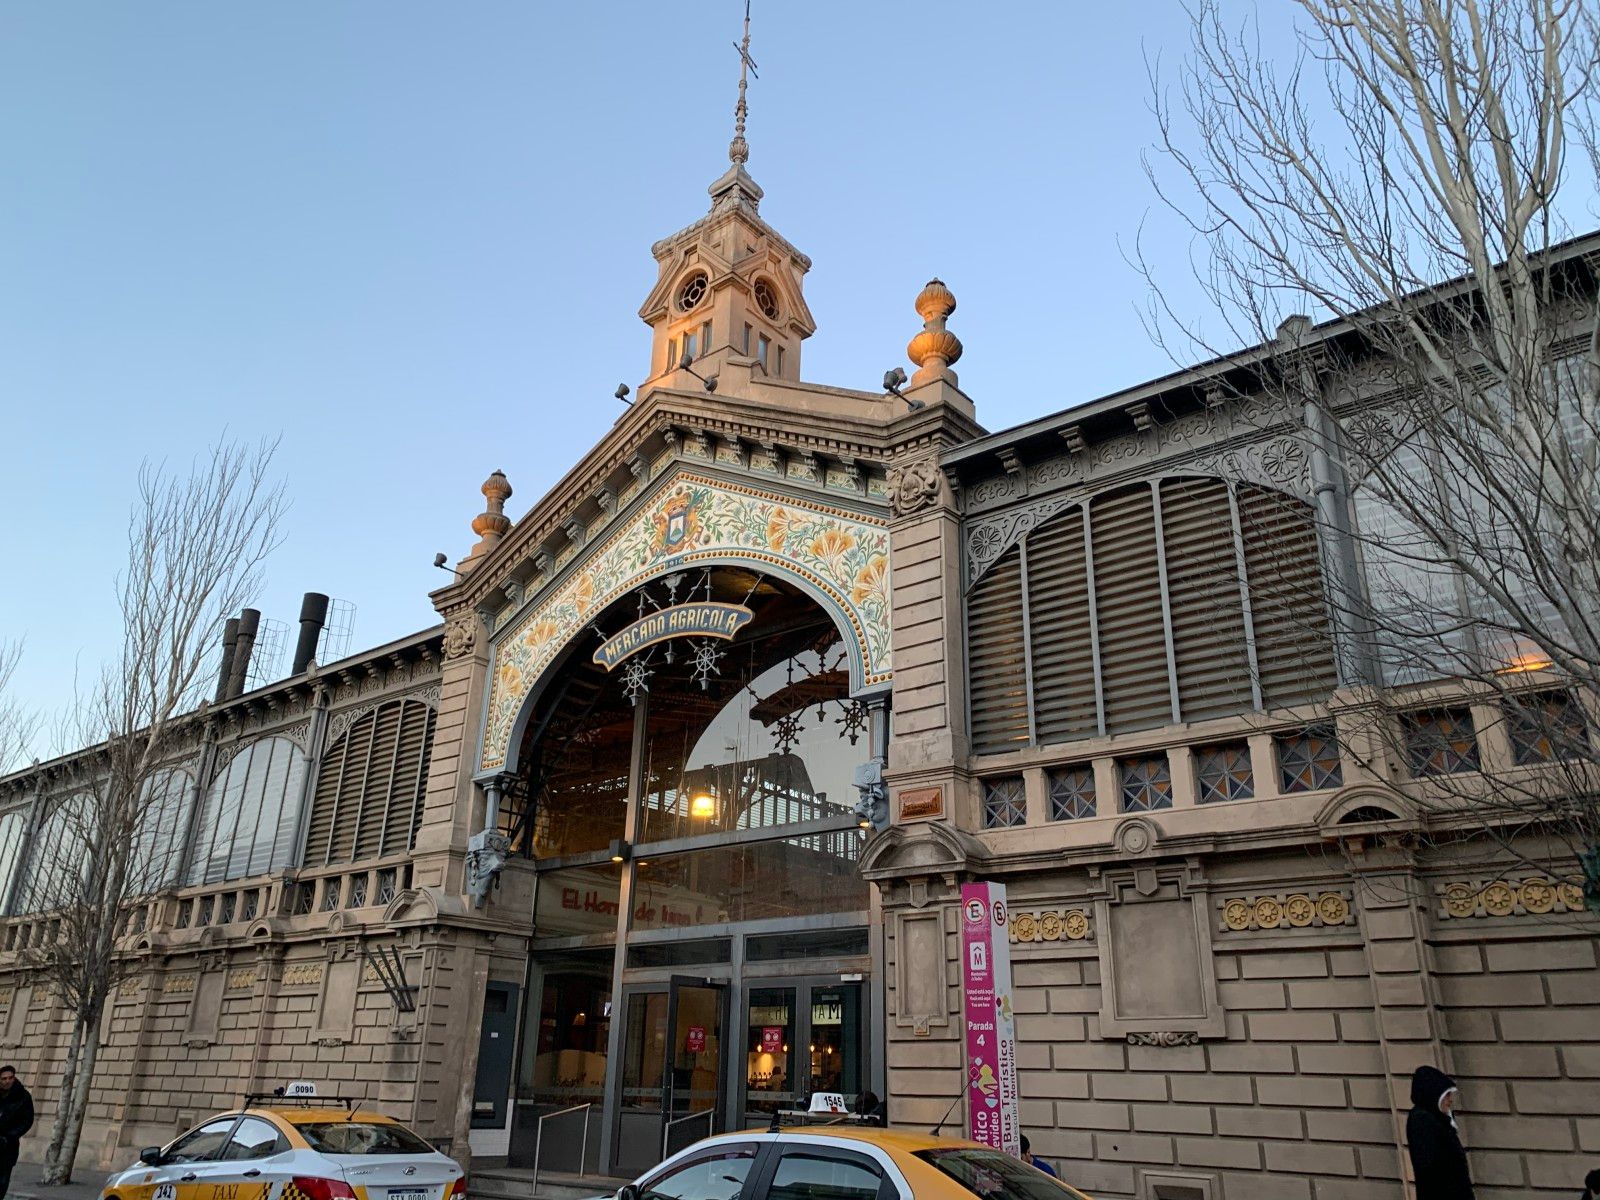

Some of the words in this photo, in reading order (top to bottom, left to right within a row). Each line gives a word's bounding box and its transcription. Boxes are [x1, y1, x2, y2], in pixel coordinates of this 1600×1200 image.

[605, 616, 665, 664] MERCADO
[669, 608, 739, 632] AGRICOLA
[968, 1021, 994, 1031] Parada
[976, 1034, 986, 1047] 4
[1000, 1040, 1010, 1109] Turístico
[1009, 1040, 1017, 1100] Montevideo
[295, 1085, 314, 1094] 0090
[823, 1095, 843, 1107] 1545
[1003, 1113, 1012, 1142] Bus
[212, 1184, 239, 1200] TAXI
